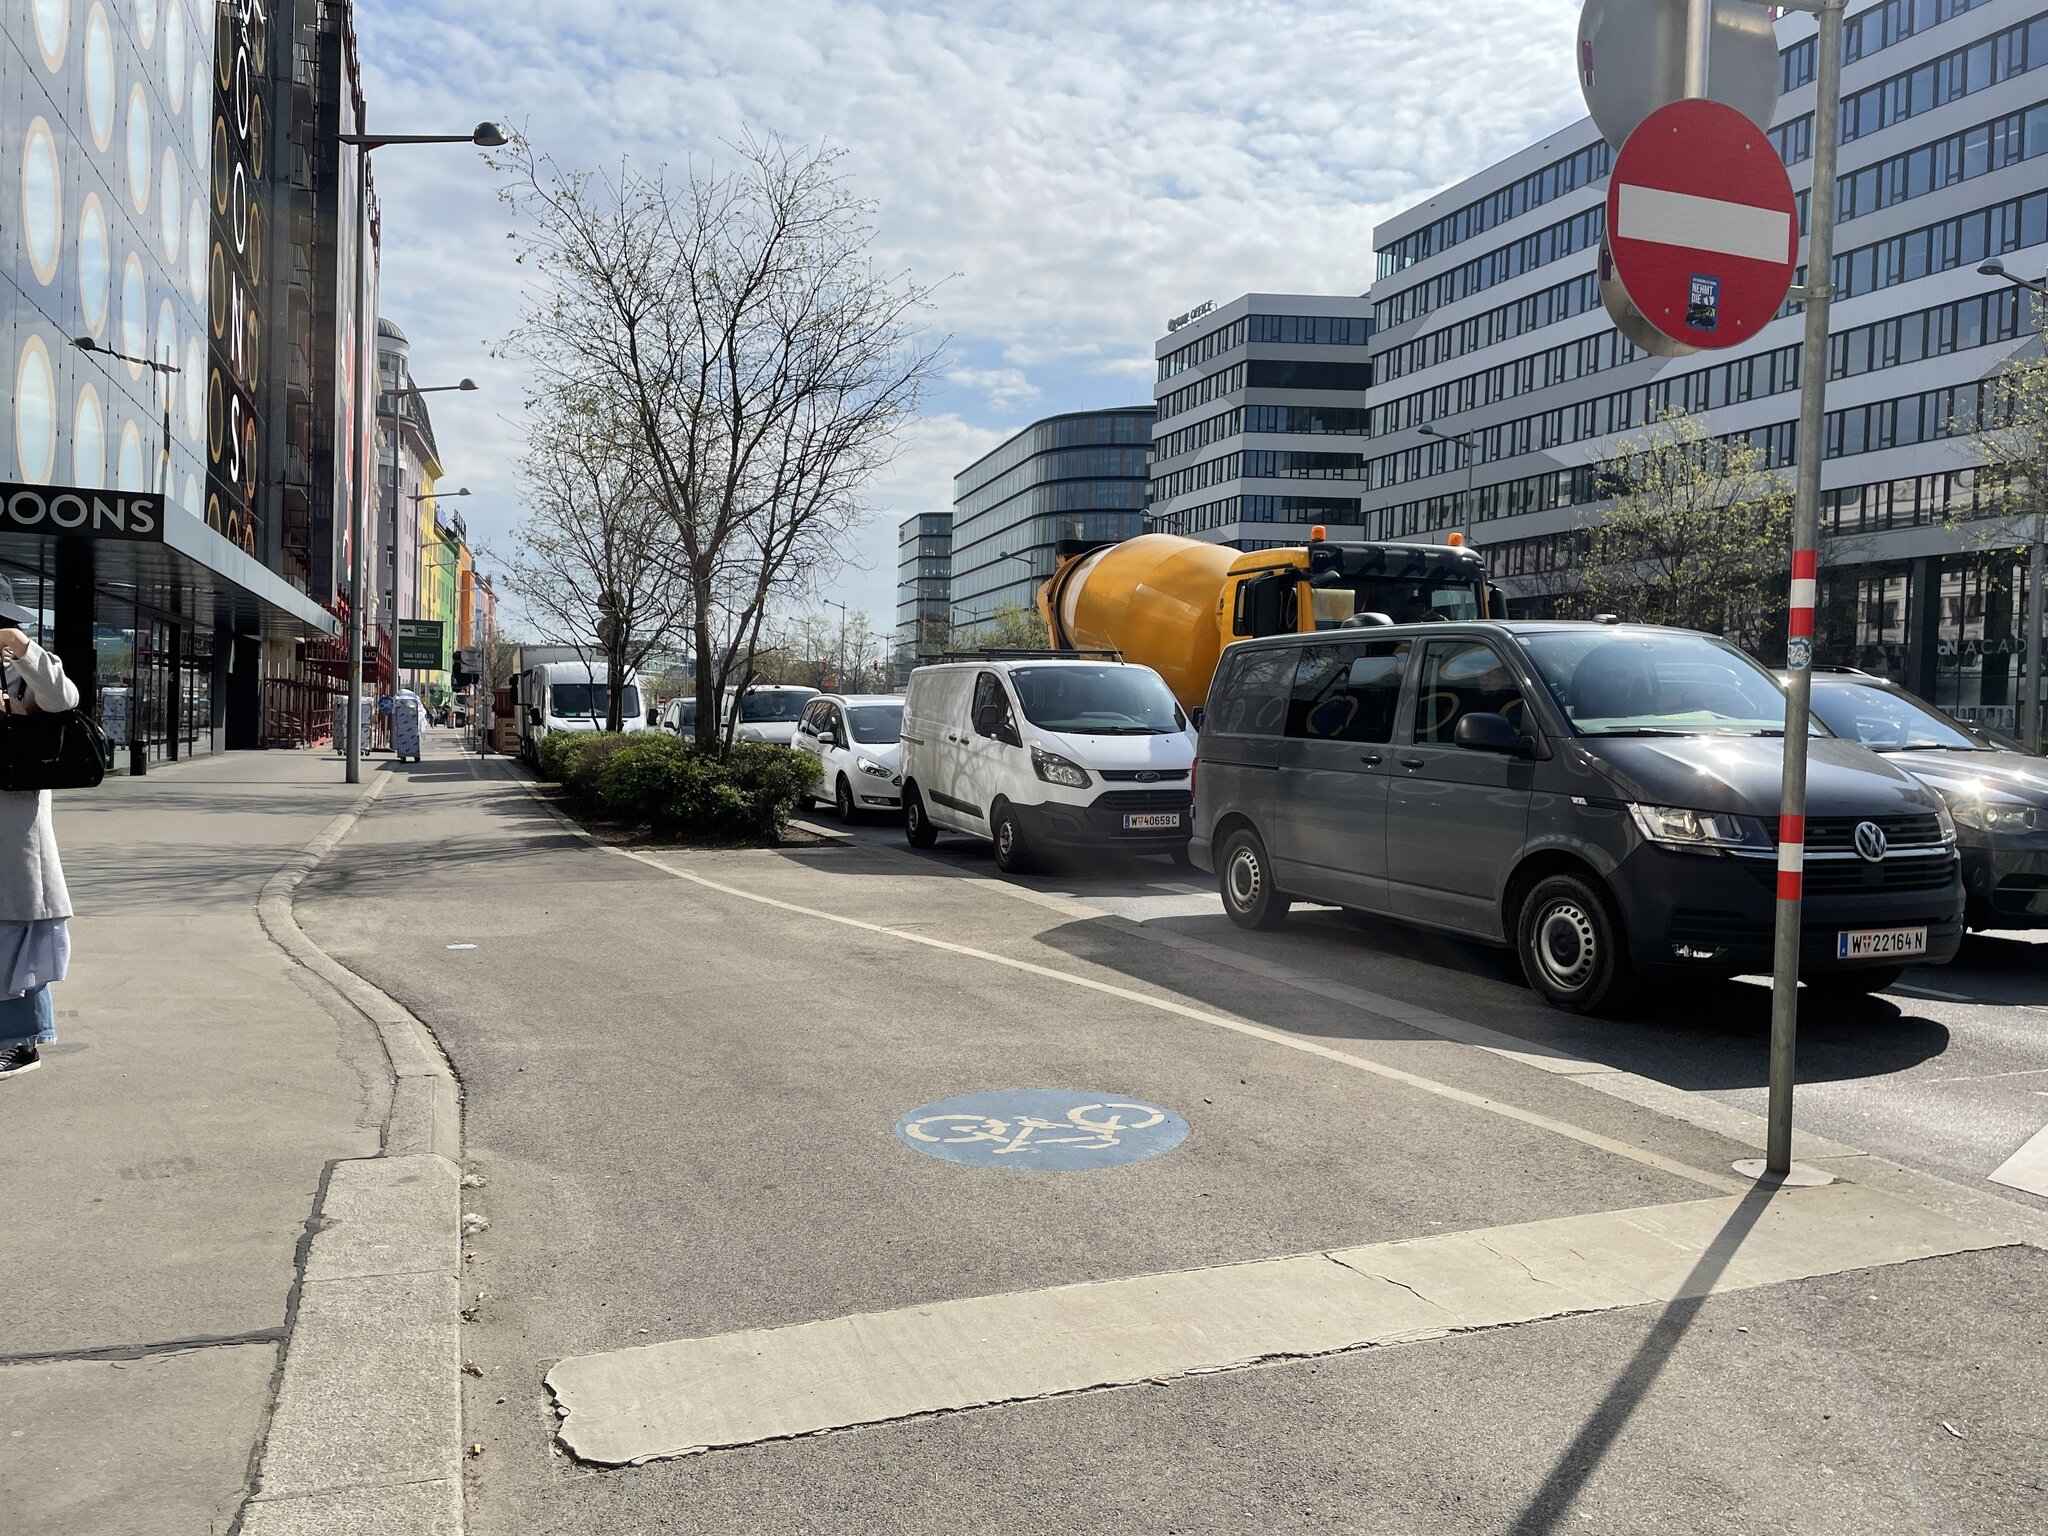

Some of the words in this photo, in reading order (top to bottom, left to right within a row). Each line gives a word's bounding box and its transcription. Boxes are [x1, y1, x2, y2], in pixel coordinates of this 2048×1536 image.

[230, 0, 252, 483] OONS
[1691, 283, 1713, 295] NEHMT
[1691, 292, 1701, 304] DIE
[0, 491, 155, 533] OONS
[1964, 638, 2027, 655] ACAD
[1144, 815, 1170, 825] 40659
[1852, 935, 1862, 953] W
[1872, 932, 1912, 952] 22164
[1914, 931, 1923, 949] N
